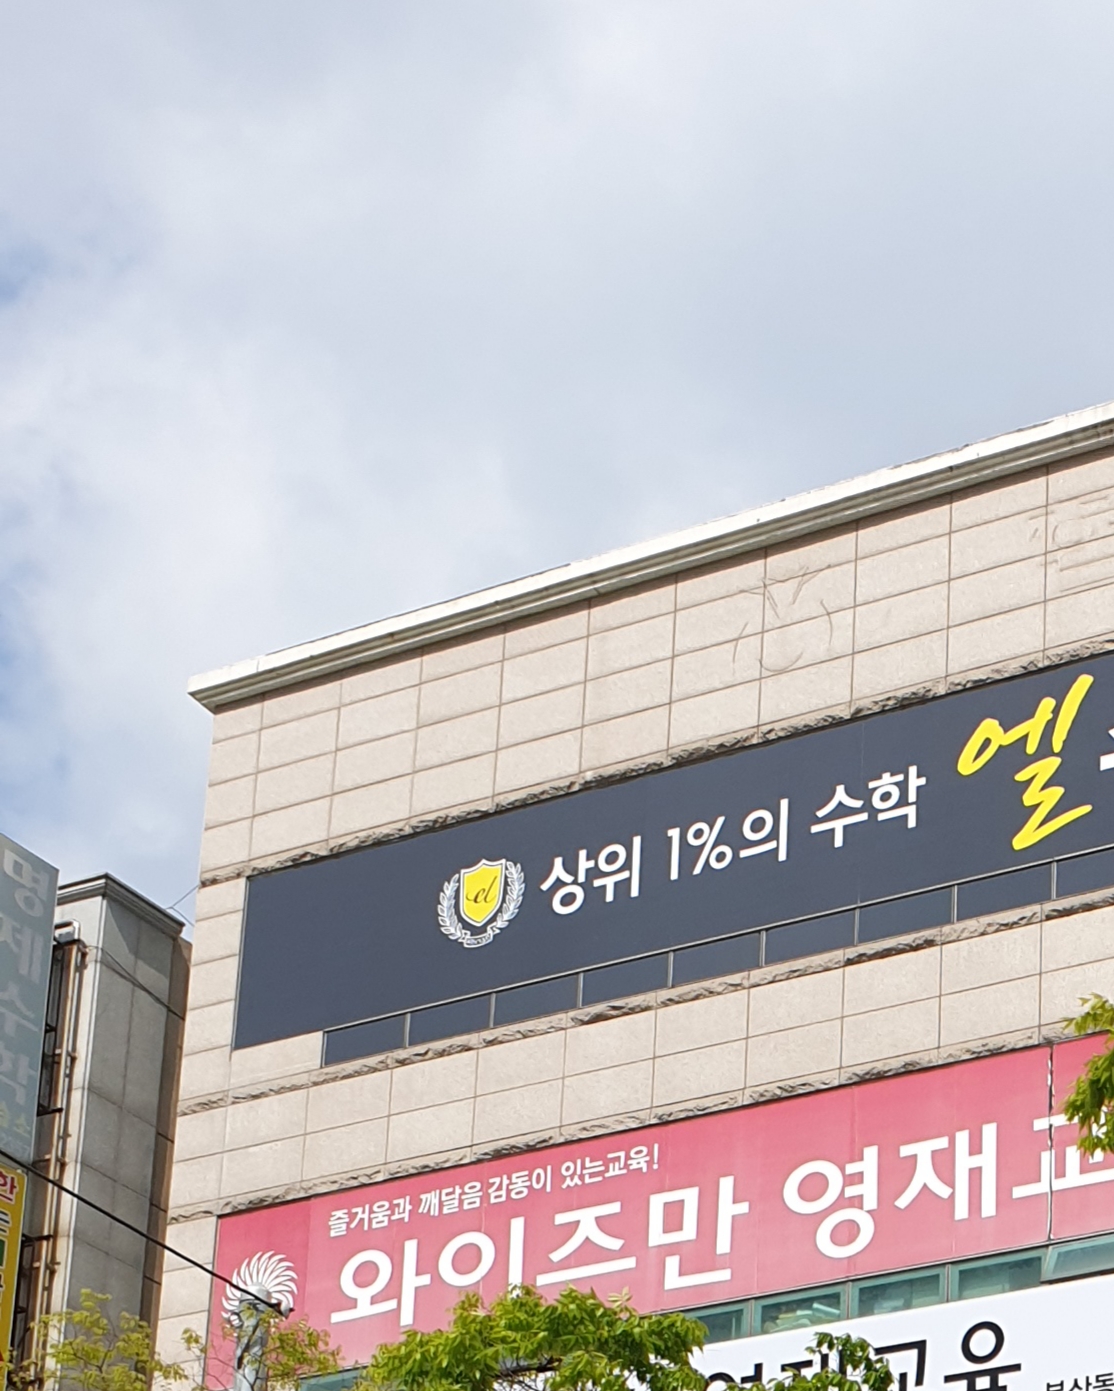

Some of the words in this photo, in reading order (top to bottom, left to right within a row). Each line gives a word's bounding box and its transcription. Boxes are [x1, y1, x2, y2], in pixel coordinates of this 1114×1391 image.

[539, 836, 643, 916] 상위
[665, 797, 791, 881] 1%의
[809, 765, 927, 849] 수학
[957, 673, 1095, 849] 엘
[328, 1192, 413, 1237] 즐거움과
[417, 1182, 485, 1219] 깨달음
[486, 1166, 554, 1209] 감동이
[330, 1175, 751, 1328] 와이즈만
